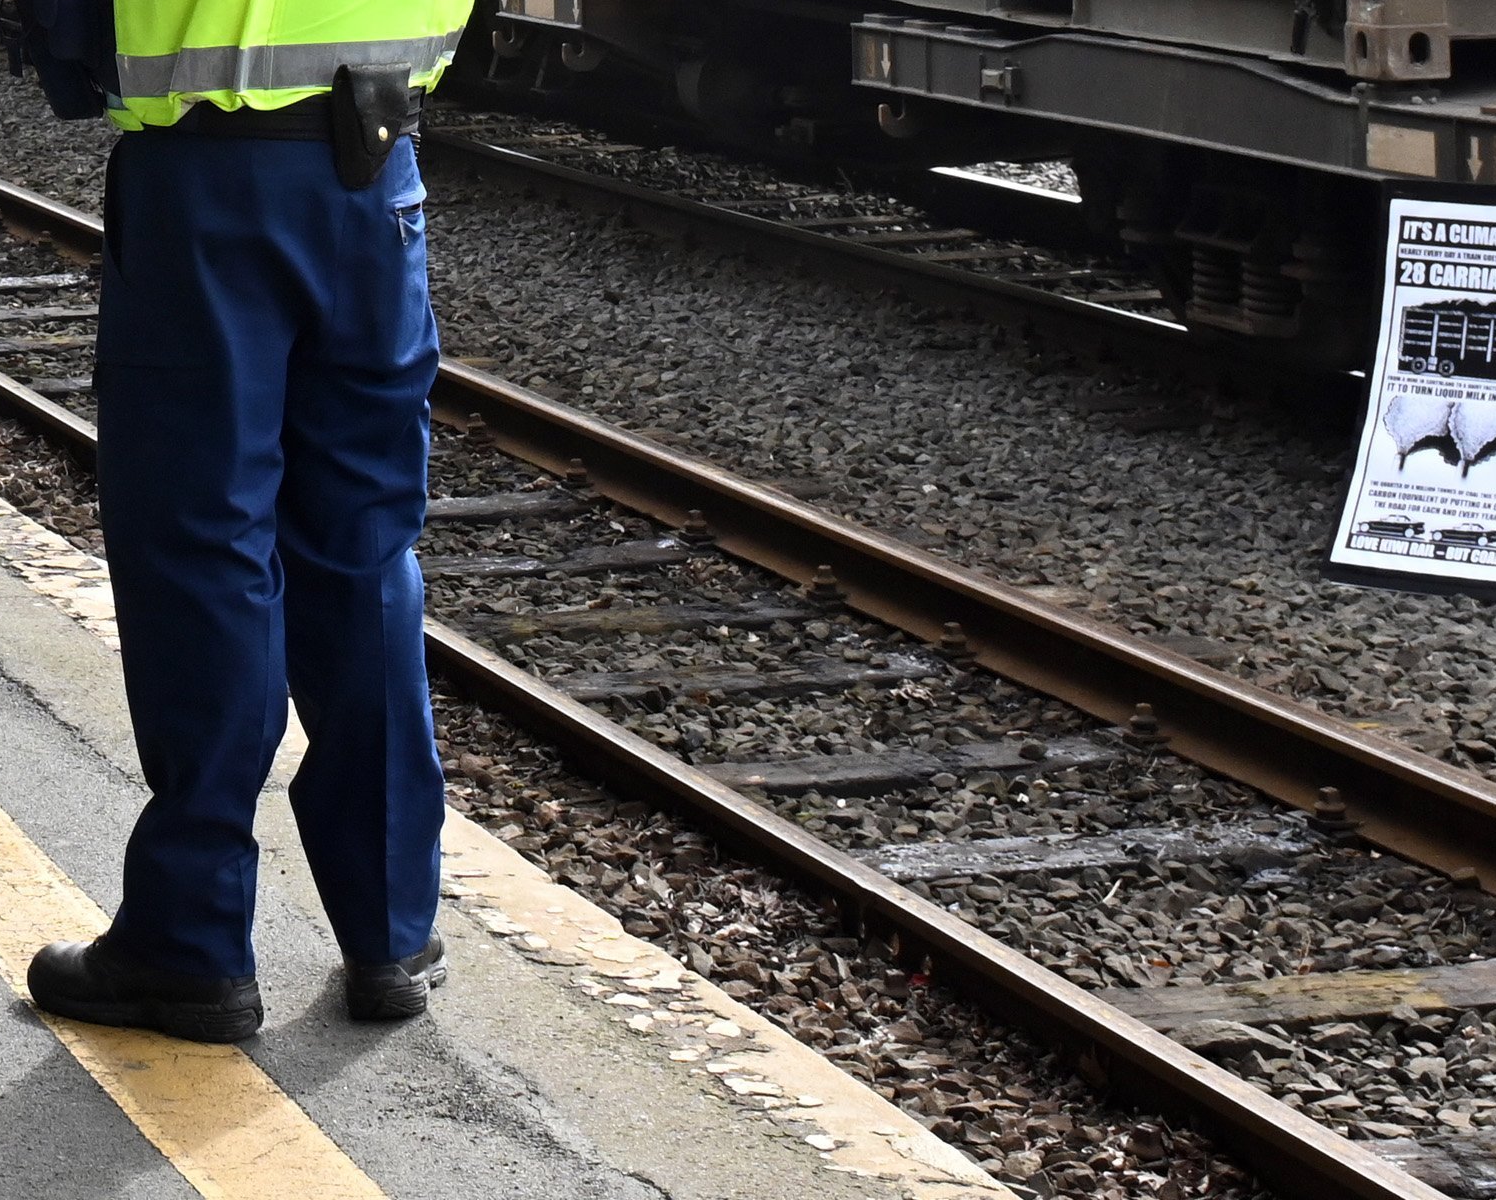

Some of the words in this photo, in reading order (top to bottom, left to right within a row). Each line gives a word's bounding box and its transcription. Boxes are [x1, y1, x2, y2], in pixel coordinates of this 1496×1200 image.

[1403, 220, 1433, 242] IT'S
[1434, 223, 1447, 243] A
[1400, 248, 1422, 256] NEARLY
[1423, 249, 1442, 257] EVERY
[1399, 260, 1426, 285] 28
[1387, 382, 1395, 391] IT
[1398, 383, 1408, 393] TO
[1411, 385, 1432, 395] TURN
[1435, 387, 1463, 399] LIQUID
[1466, 391, 1485, 401] MILK
[1368, 489, 1397, 499] CARBON
[1398, 492, 1438, 504] EQUIVALENT
[1450, 498, 1480, 508] PUTTING
[1374, 500, 1386, 508] THE
[1388, 502, 1407, 511] ROAD
[1408, 504, 1421, 512] FOR
[1422, 505, 1441, 514] EACH
[1442, 508, 1457, 516] AND
[1458, 510, 1479, 519] EVERY
[1350, 535, 1379, 550] LOVE
[1379, 539, 1409, 554] KIWI
[1410, 542, 1434, 558] RAIL
[1445, 547, 1471, 561] BUT
